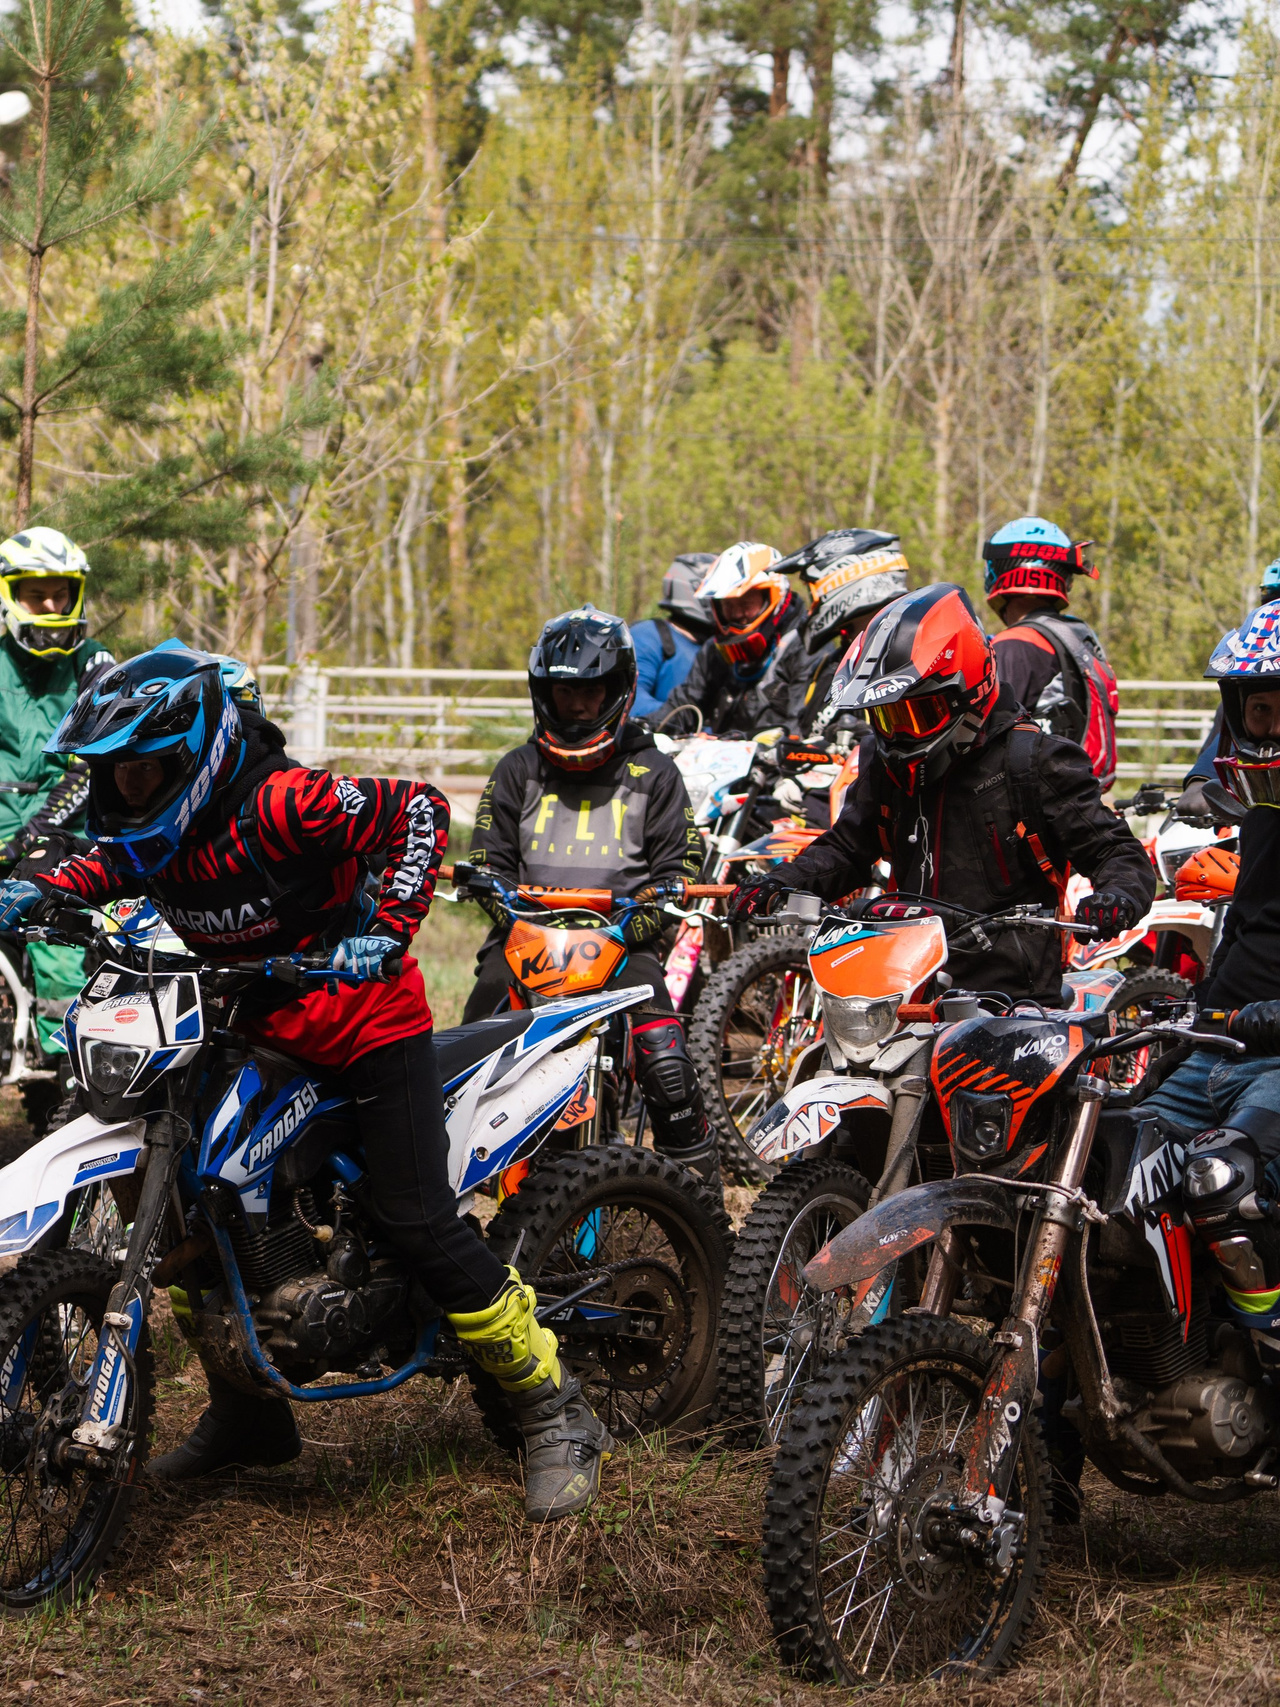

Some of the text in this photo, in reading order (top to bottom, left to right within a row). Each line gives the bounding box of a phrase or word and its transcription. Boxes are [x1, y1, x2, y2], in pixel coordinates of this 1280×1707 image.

[863, 680, 909, 704] Airoh
[534, 794, 628, 840] FLY
[884, 905, 921, 918] IGP
[813, 923, 862, 950] KAYO
[521, 940, 601, 980] KAYO
[102, 994, 164, 1012] PROGAI
[1013, 1034, 1066, 1062] KAYO
[248, 1080, 319, 1173] PROGASI
[321, 1290, 345, 1300] PROGASI
[90, 1333, 119, 1421] PROGAS
